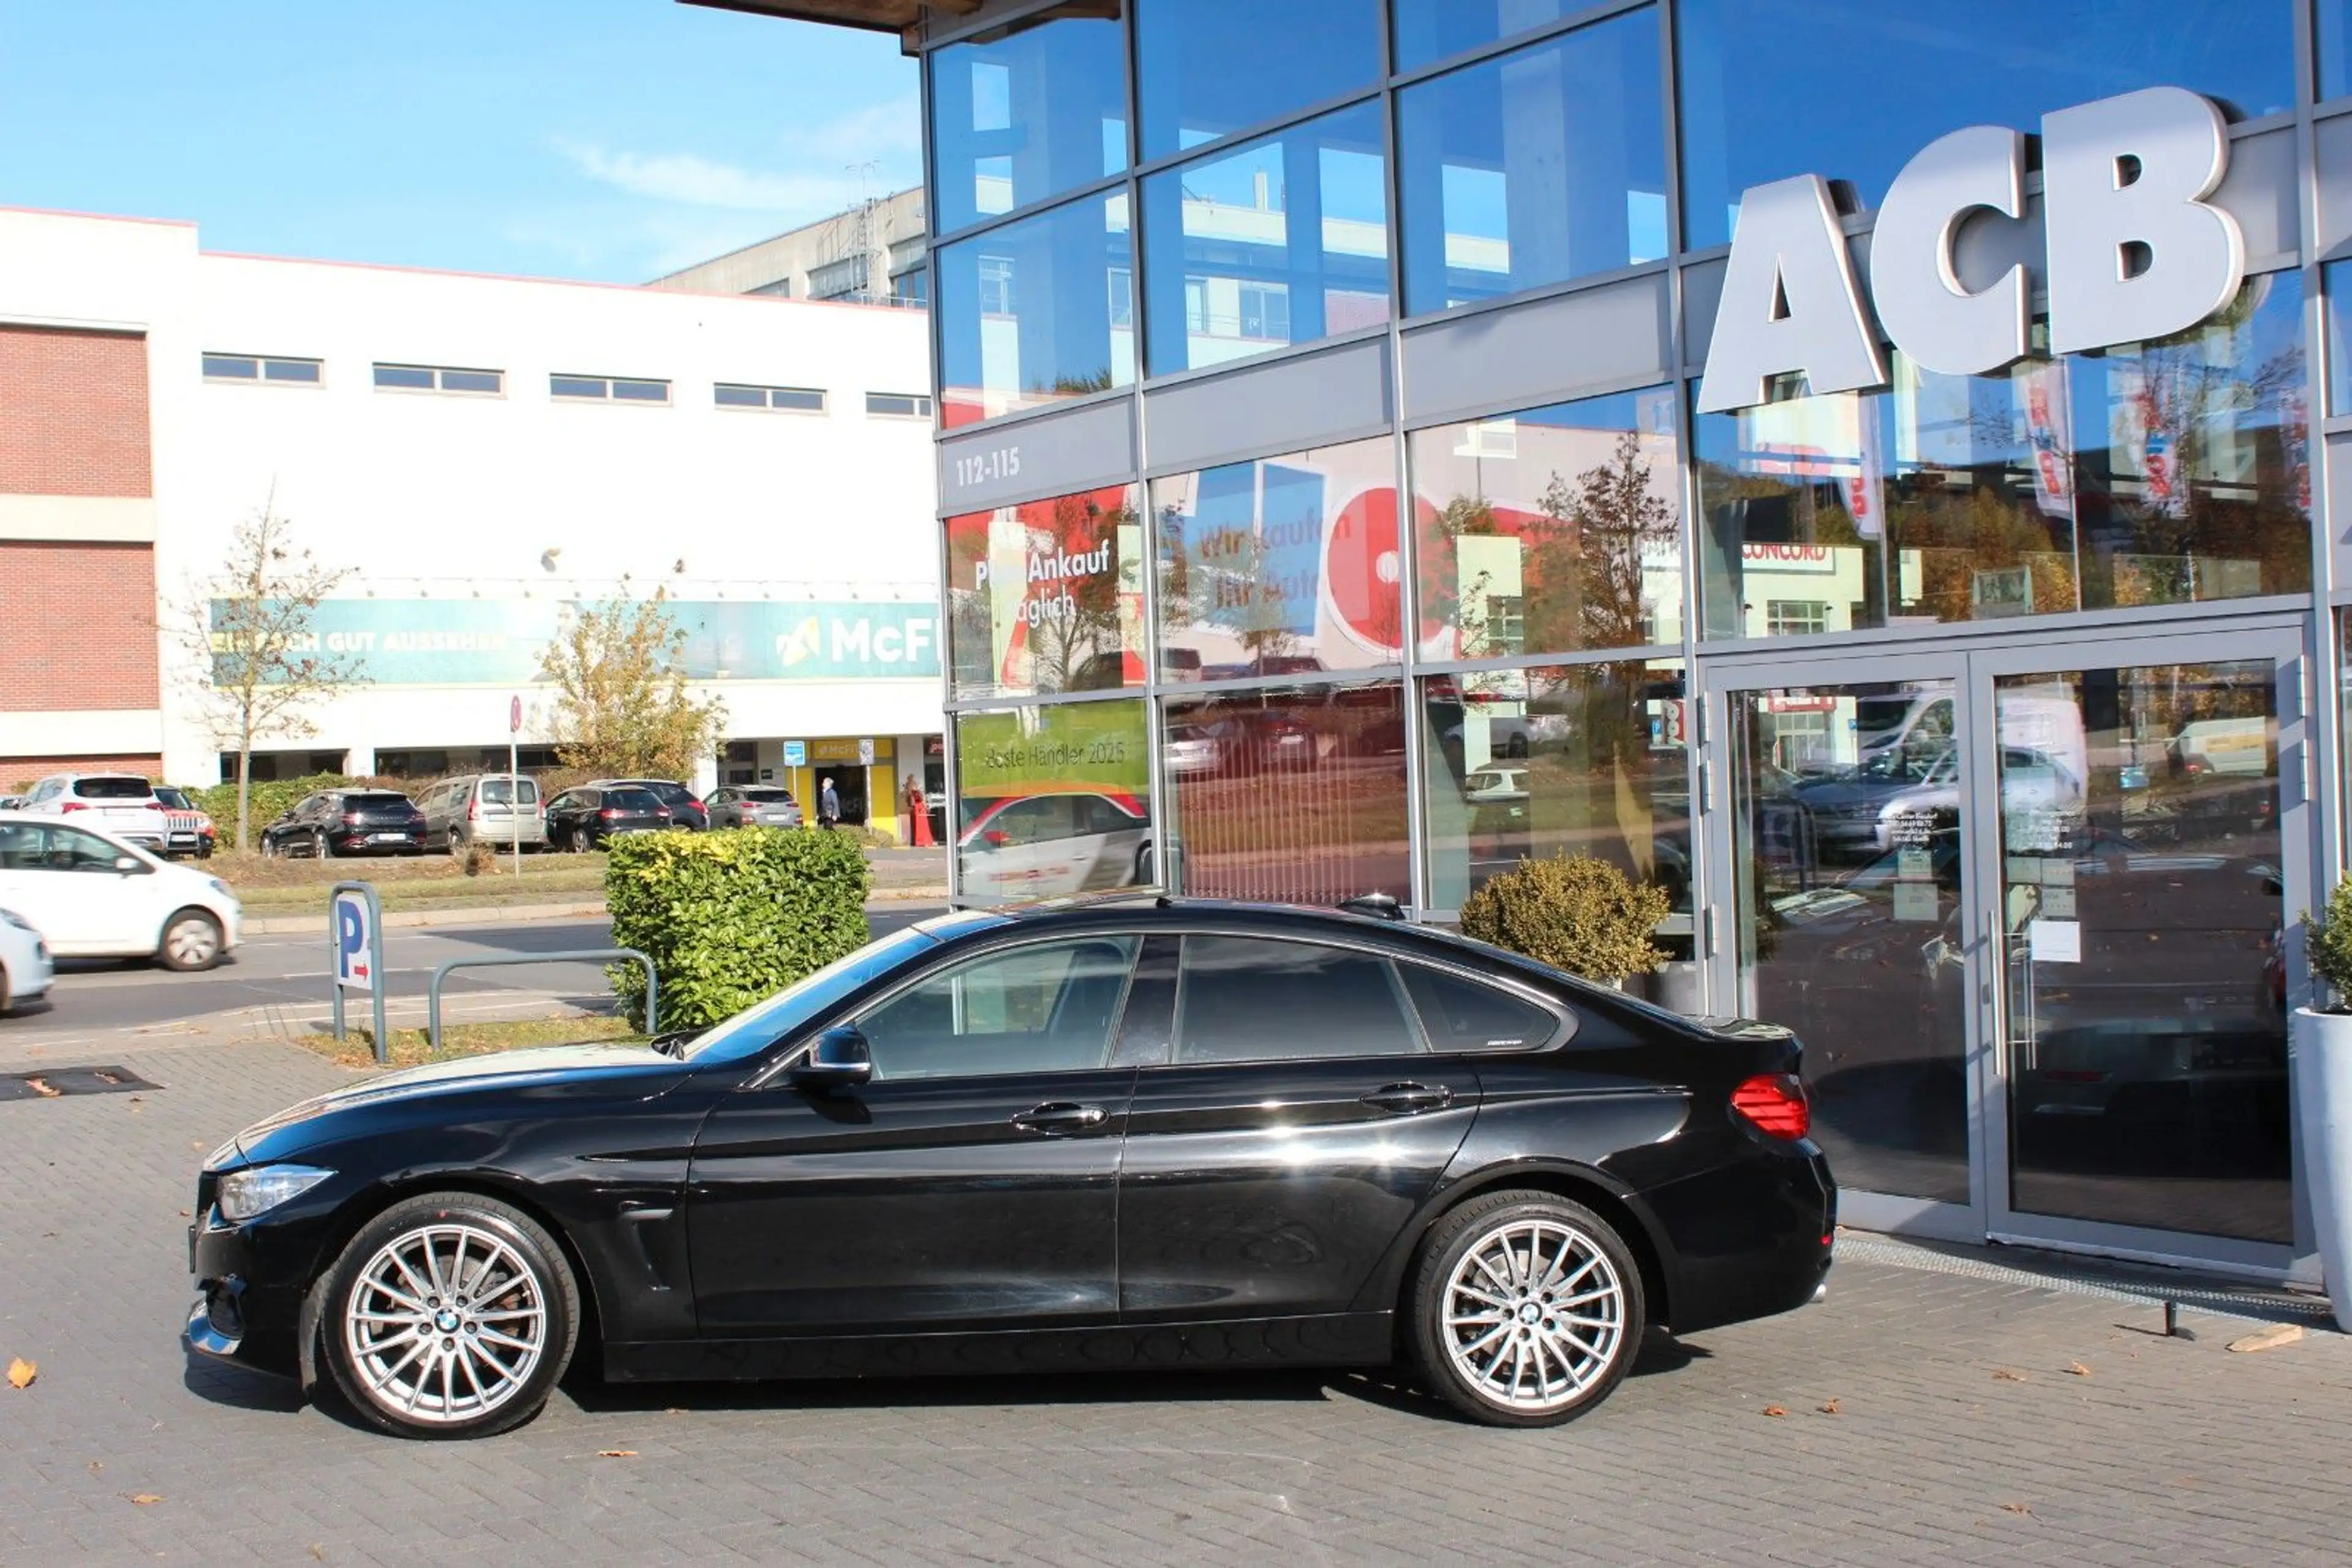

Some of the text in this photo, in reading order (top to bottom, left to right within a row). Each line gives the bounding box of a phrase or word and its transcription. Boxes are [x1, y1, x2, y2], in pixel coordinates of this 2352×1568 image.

[1696, 86, 2246, 415] ACB
[957, 447, 1020, 487] 112-115
[1028, 538, 1109, 582] Ankauf
[326, 631, 375, 652] GUT
[1087, 742, 1125, 764] 2025
[337, 900, 363, 978] P
